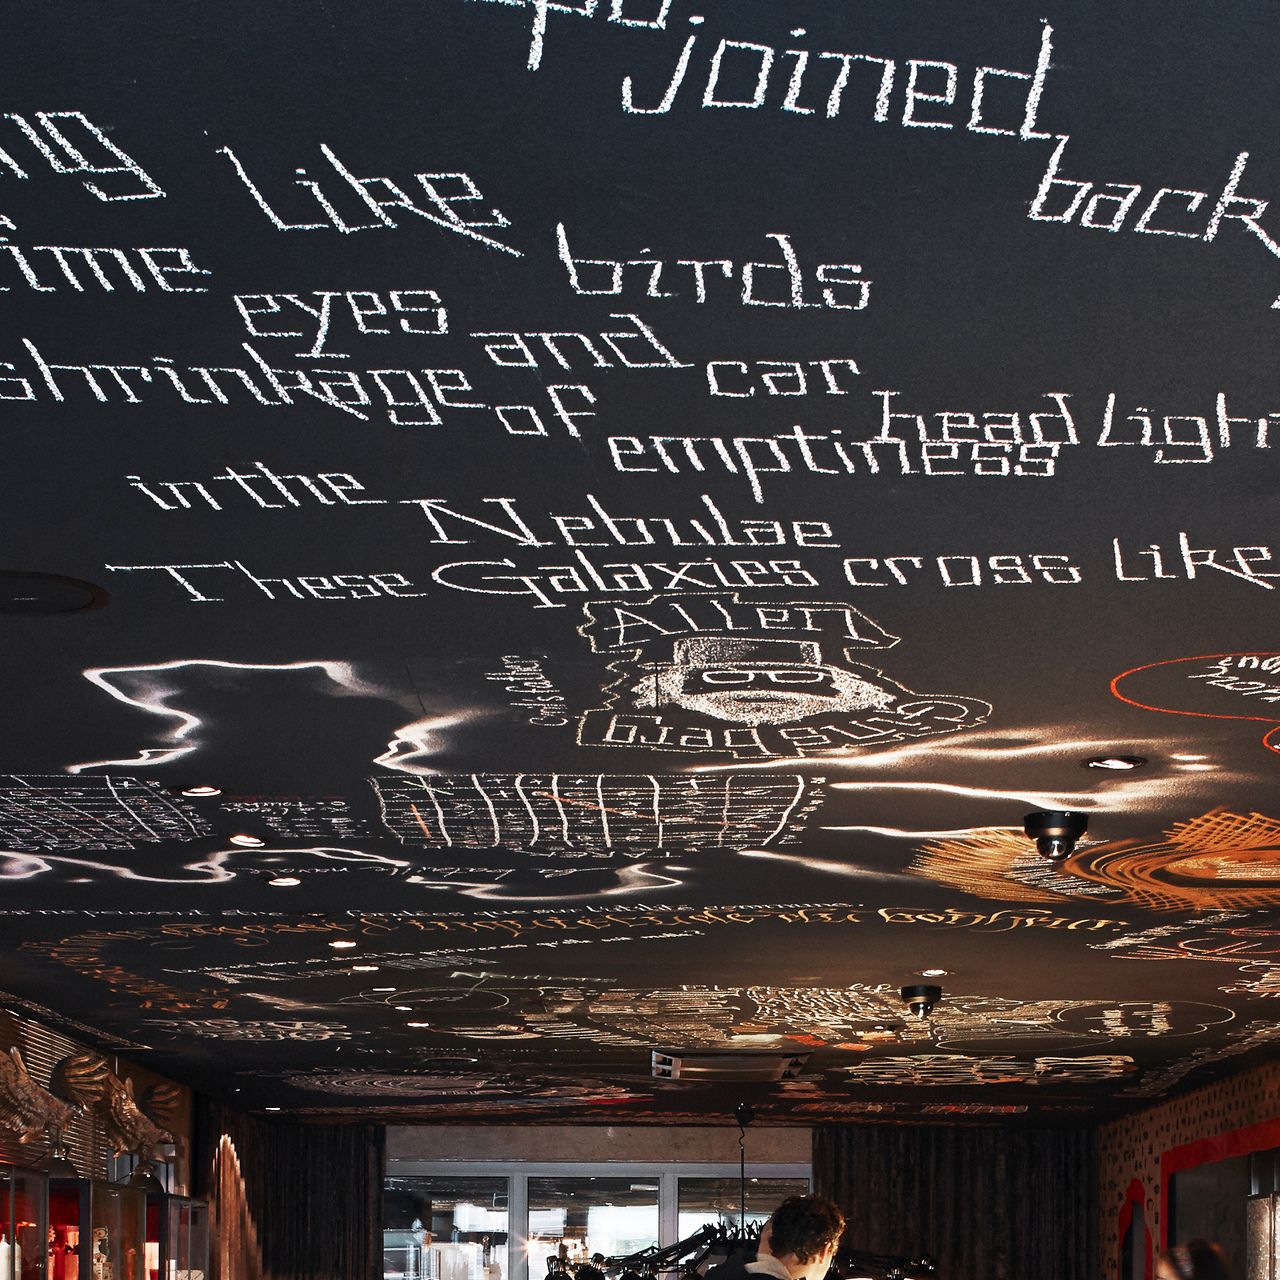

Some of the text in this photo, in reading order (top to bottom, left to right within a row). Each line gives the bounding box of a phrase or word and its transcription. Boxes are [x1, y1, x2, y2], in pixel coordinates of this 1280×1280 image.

[621, 16, 1063, 140] joined
[557, 222, 871, 311] birds
[233, 290, 860, 397] eyes and car
[494, 384, 596, 438] of
[873, 391, 1081, 448] head
[609, 424, 1060, 503] emptiness
[400, 493, 842, 549] Nebulae
[106, 557, 428, 602] These
[431, 548, 820, 610] Galaxies
[844, 552, 1083, 589] cross
